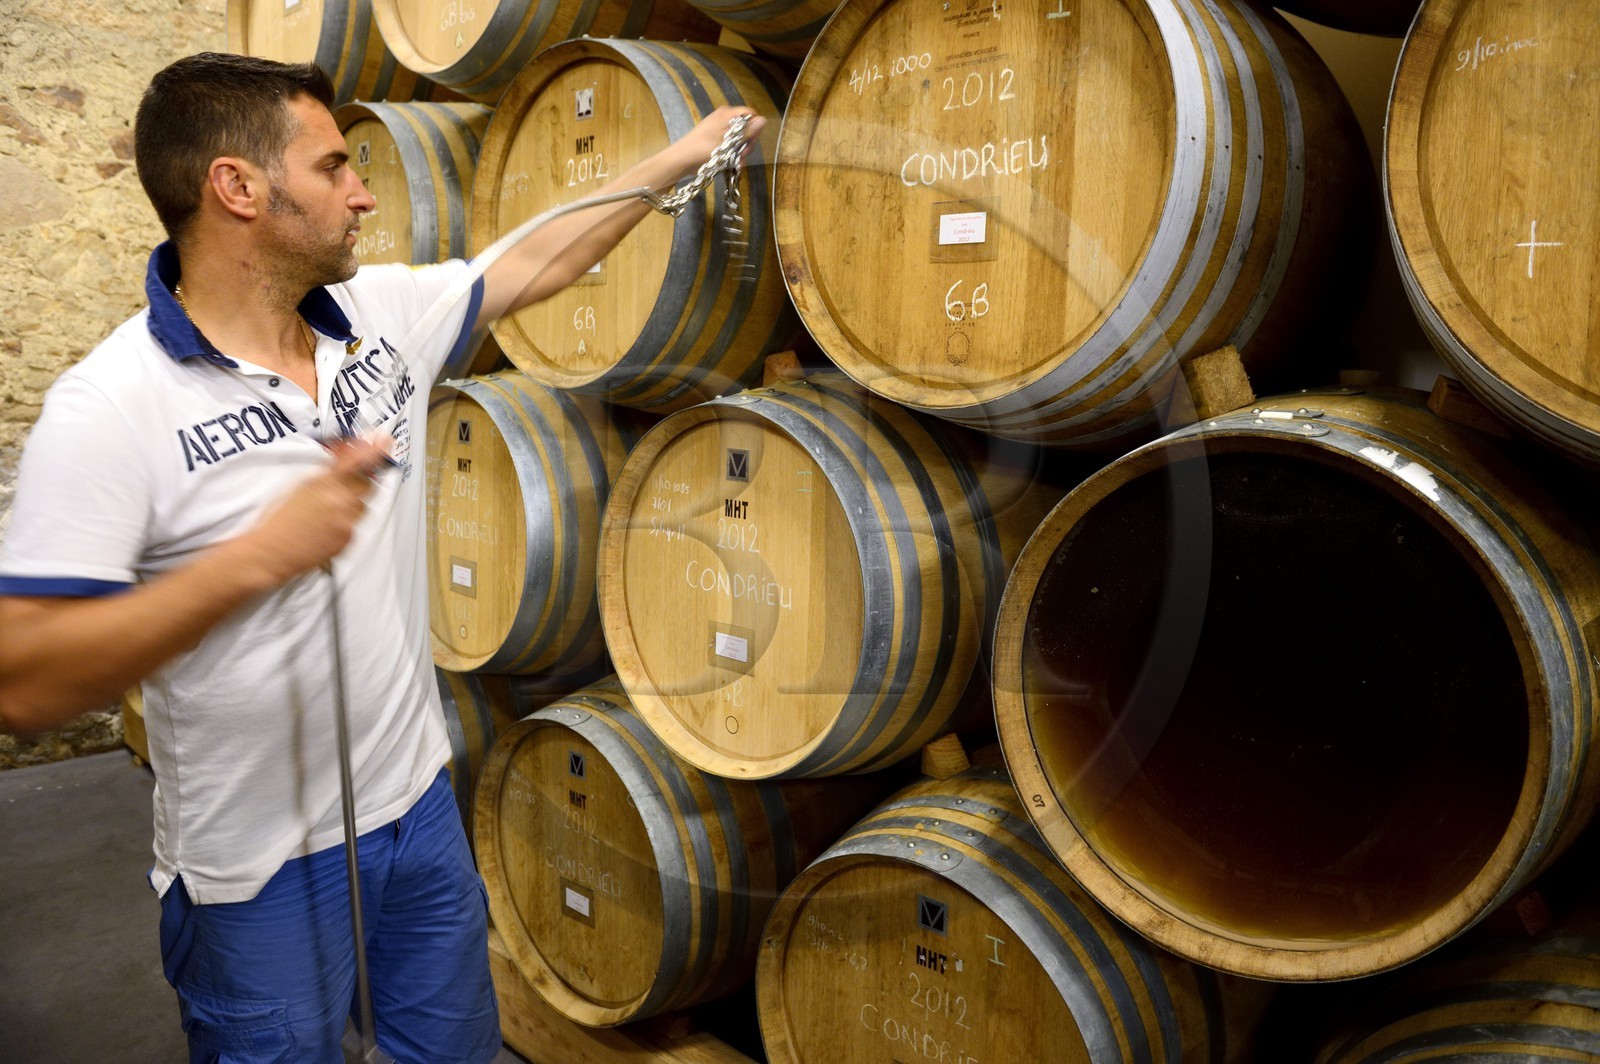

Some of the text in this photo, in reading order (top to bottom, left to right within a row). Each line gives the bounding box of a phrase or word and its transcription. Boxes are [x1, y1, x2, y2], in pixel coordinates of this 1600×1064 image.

[849, 52, 931, 95] 4/12 1000
[943, 67, 1016, 110] 2012
[576, 135, 594, 155] MHT
[567, 153, 609, 187] 2012
[945, 279, 989, 320] 6B
[177, 401, 298, 472] AERON
[457, 457, 472, 473] MHT
[452, 473, 479, 501] 2012
[725, 498, 749, 519] MHT
[716, 518, 760, 553] 2012
[569, 789, 587, 810] MHT
[563, 804, 599, 843] 2012
[916, 945, 948, 974] MHT
[909, 972, 971, 1030] 2012
